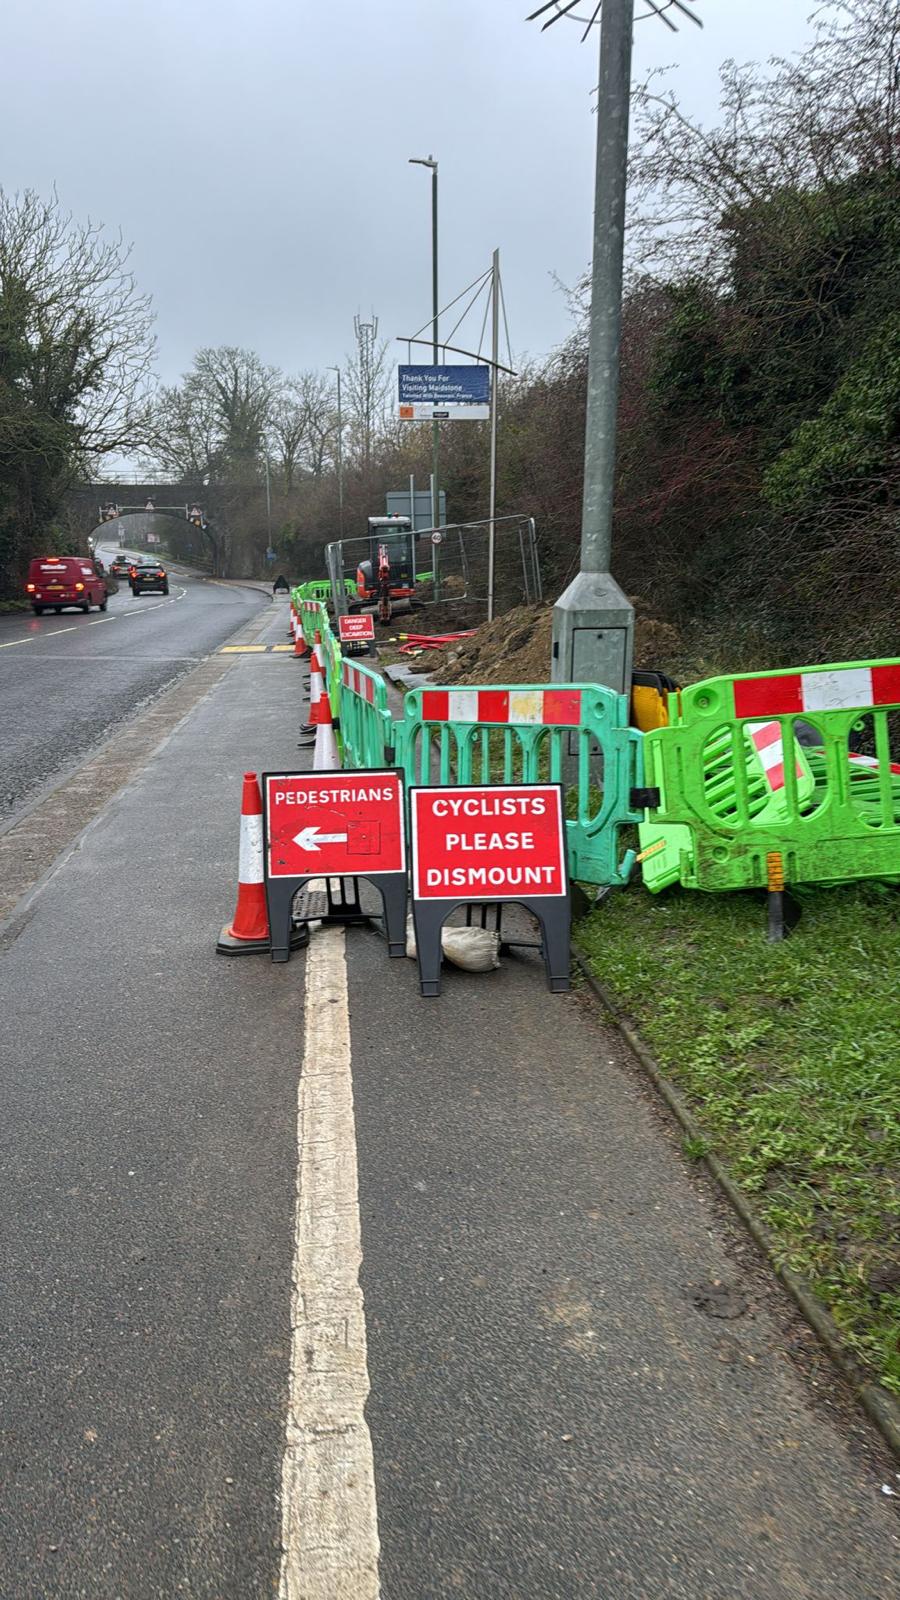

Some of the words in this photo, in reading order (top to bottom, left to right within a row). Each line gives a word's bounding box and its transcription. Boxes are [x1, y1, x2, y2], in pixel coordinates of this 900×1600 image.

[402, 374, 422, 382] Thank
[424, 374, 437, 382] You
[438, 374, 450, 382] For
[402, 384, 427, 392] Visiting
[429, 384, 463, 392] Maidstone
[275, 788, 393, 805] PEDESTRIANS
[432, 798, 546, 817] CYCLISTS
[445, 832, 535, 851] PLEASE
[427, 866, 556, 887] DISMOUNT
